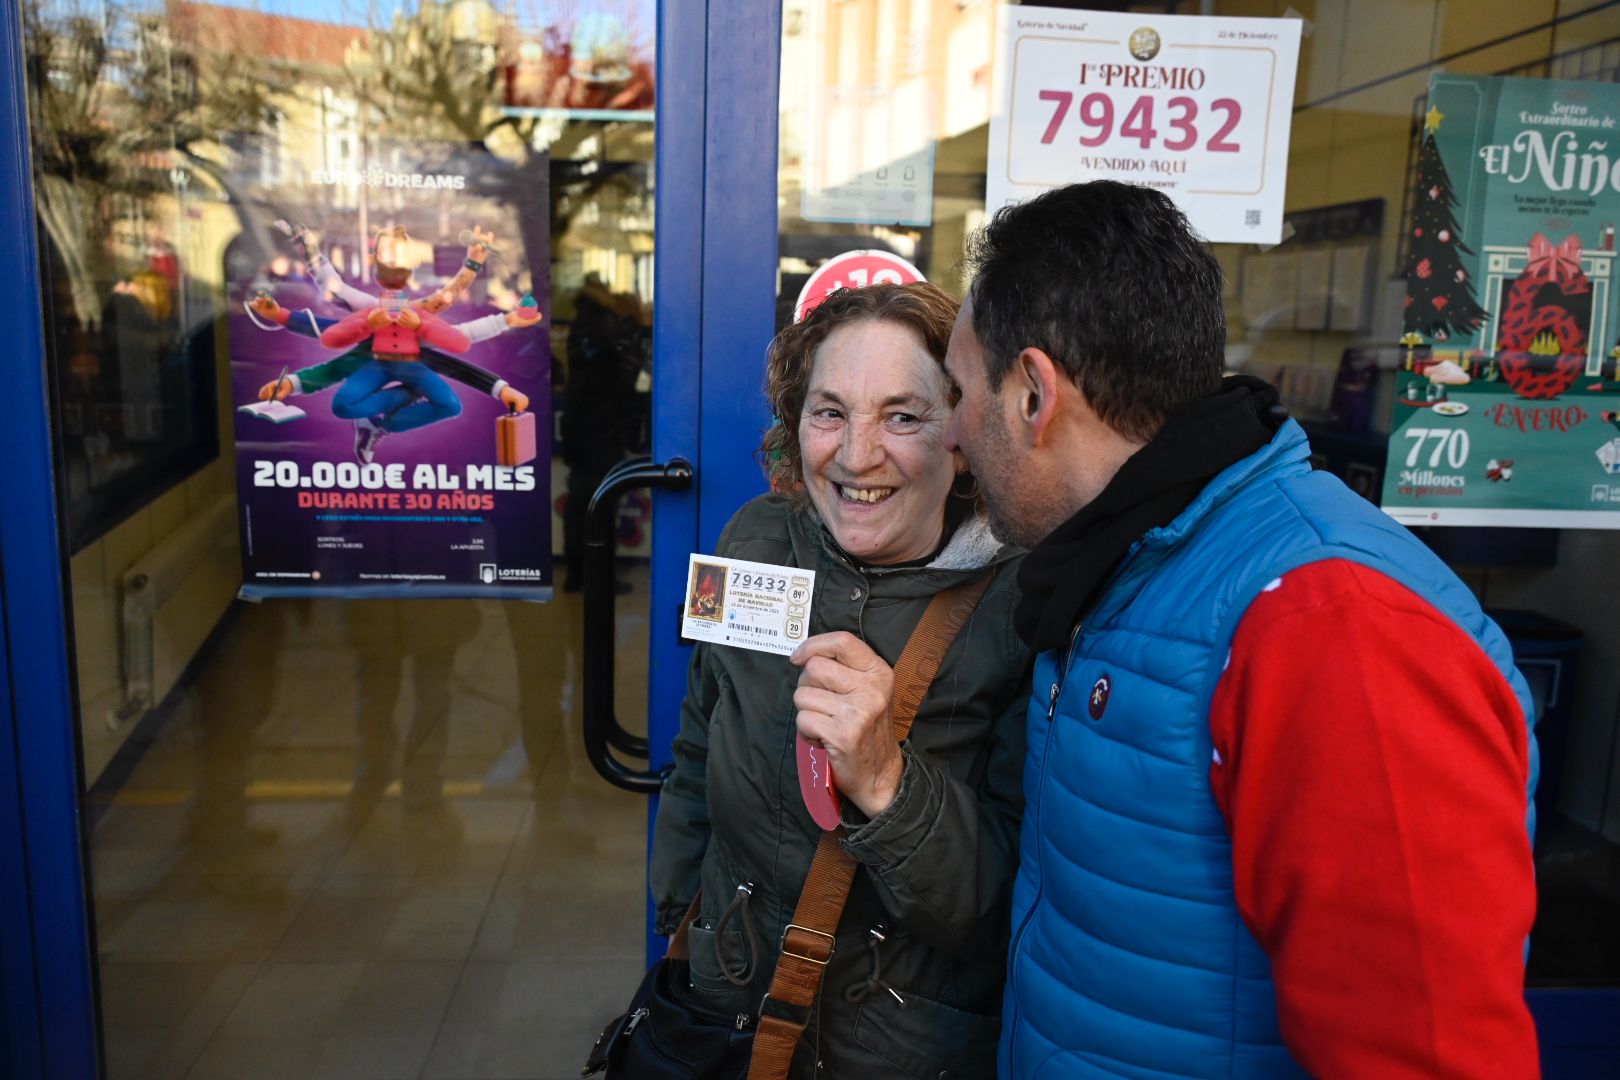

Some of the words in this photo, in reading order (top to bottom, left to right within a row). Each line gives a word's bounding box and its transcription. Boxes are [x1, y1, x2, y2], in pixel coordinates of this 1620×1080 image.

[1099, 63, 1205, 91] PREMIO
[1551, 101, 1588, 115] Sorteo
[1039, 90, 1242, 153] 79432
[1519, 111, 1600, 127] Extraordinario
[1601, 116, 1616, 128] de
[1081, 156, 1145, 172] VENDIDO
[1150, 158, 1187, 175] AQUÍ
[1478, 144, 1511, 175] El
[1404, 427, 1470, 470] 770
[253, 460, 406, 490] 20.000€
[413, 463, 460, 490] AL
[466, 464, 536, 491] MES
[1398, 467, 1466, 488] Millones
[298, 492, 401, 509] DURANTE
[404, 493, 433, 510] 30
[437, 489, 495, 511] AÑOS
[1415, 486, 1464, 499] premios
[498, 567, 541, 577] LOTERÍAS
[732, 572, 786, 593] 79432
[729, 590, 753, 598] LOTERÍA
[754, 594, 785, 603] NACIONAL
[747, 599, 774, 608] NAVIDAD
[790, 623, 799, 632] 20
